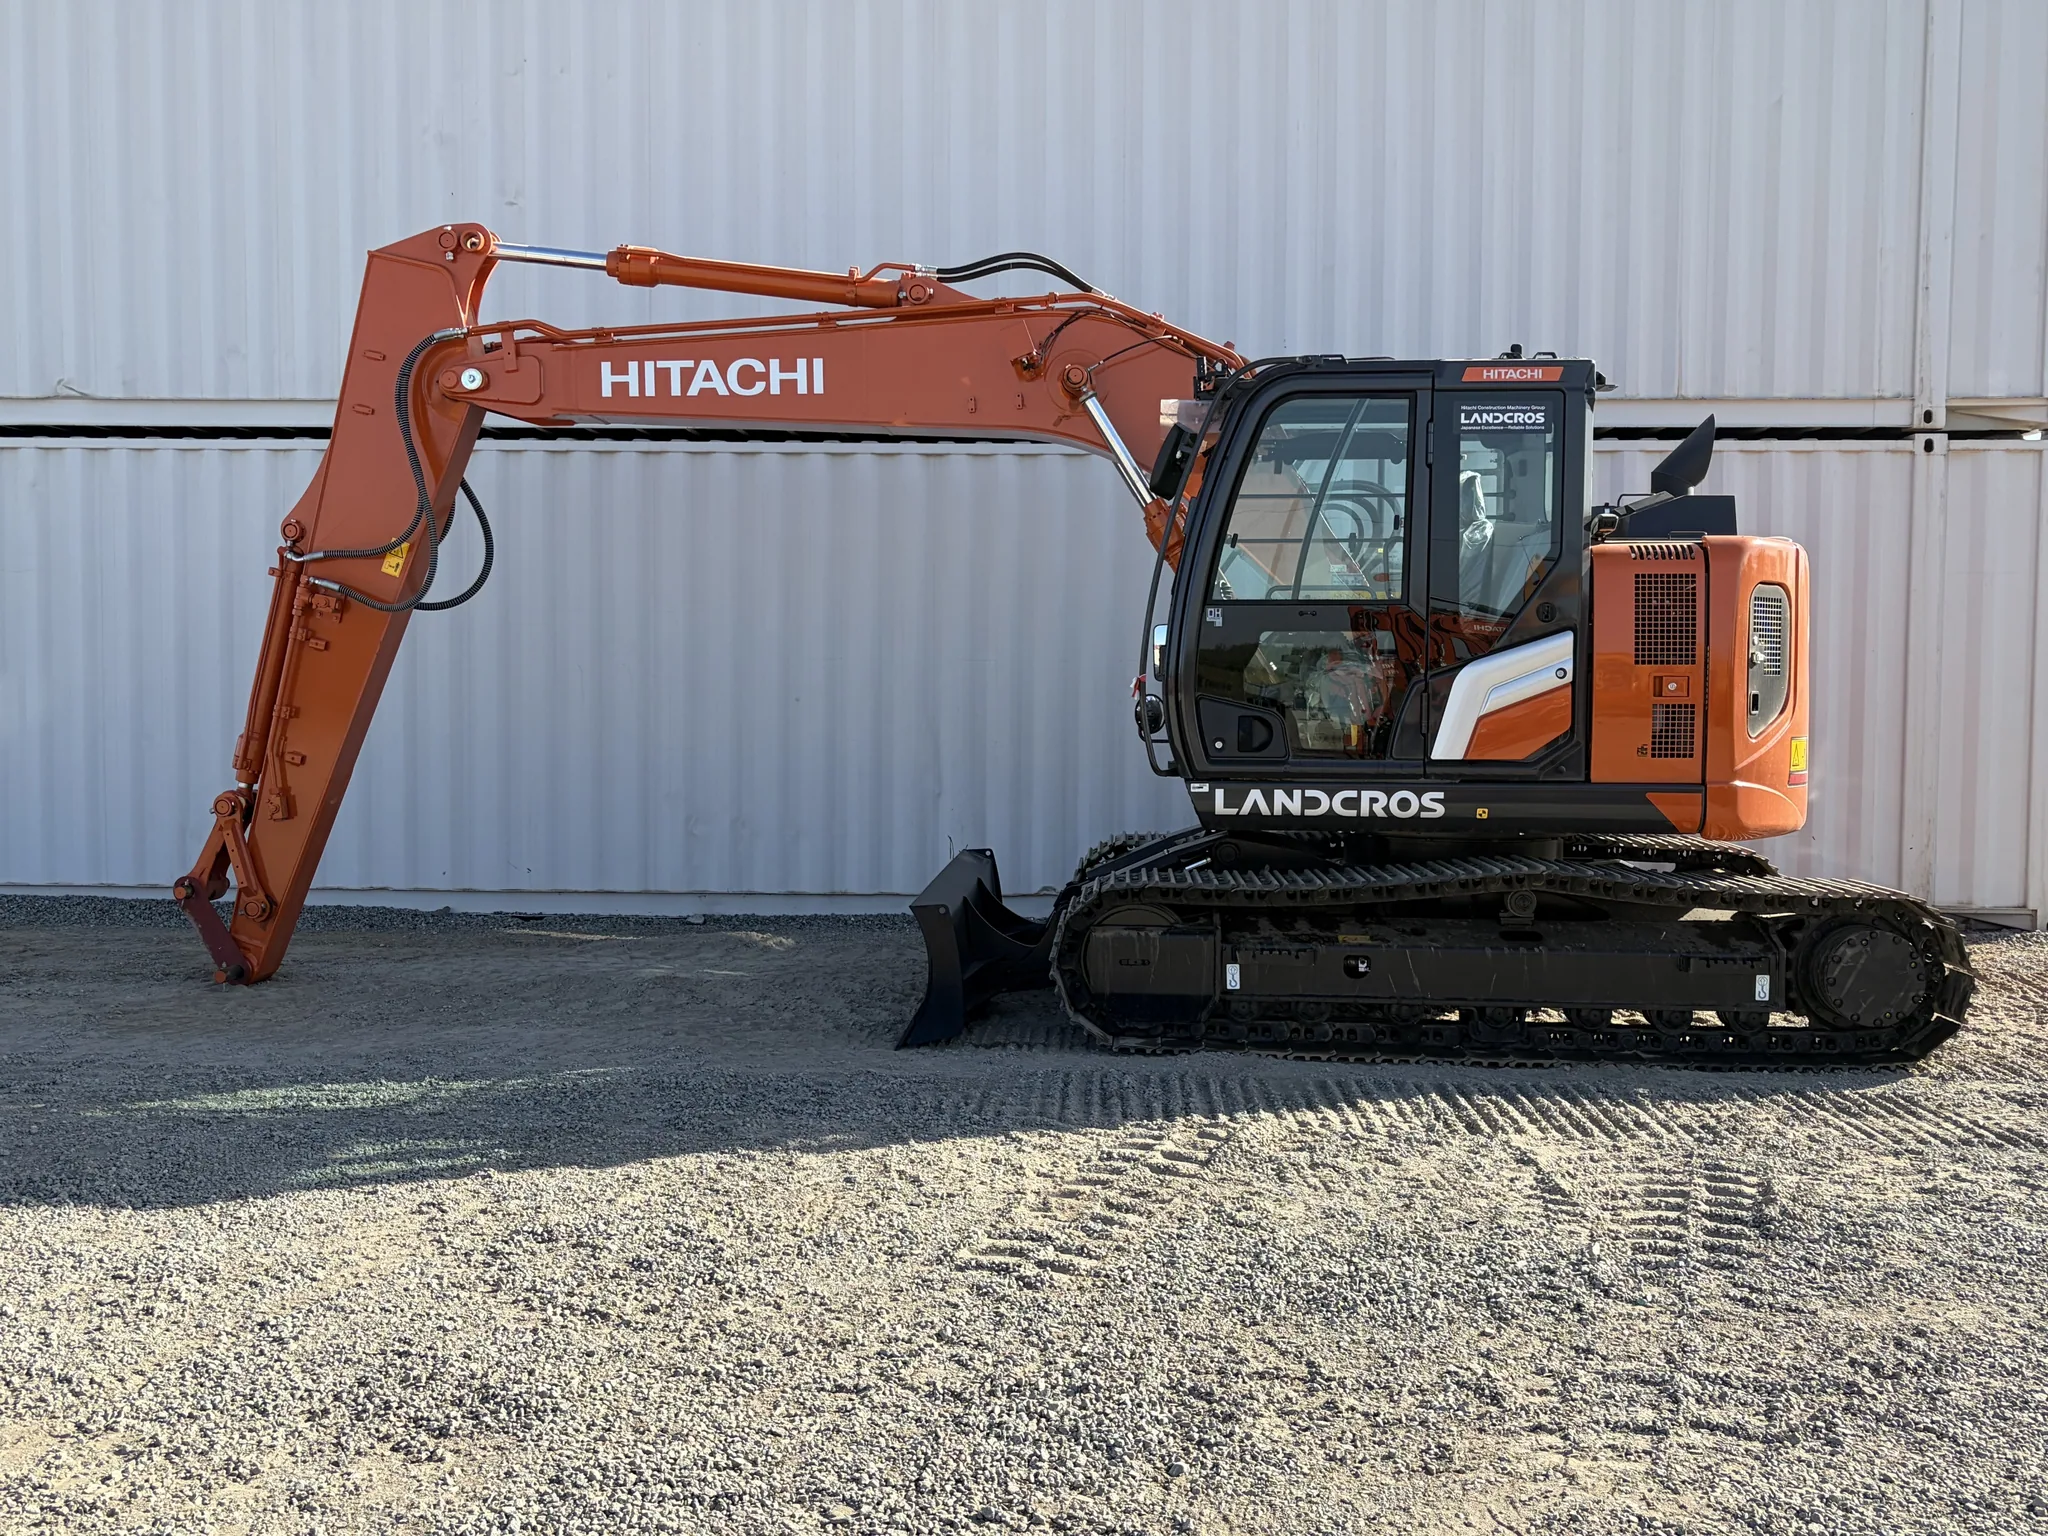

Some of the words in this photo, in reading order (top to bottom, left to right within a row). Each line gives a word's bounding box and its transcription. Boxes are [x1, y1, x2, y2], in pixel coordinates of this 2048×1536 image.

[601, 358, 824, 397] HITACHI
[1483, 368, 1543, 379] HITACHI
[1460, 412, 1545, 424] LANDCROS
[1214, 788, 1446, 818] LANDCROS
